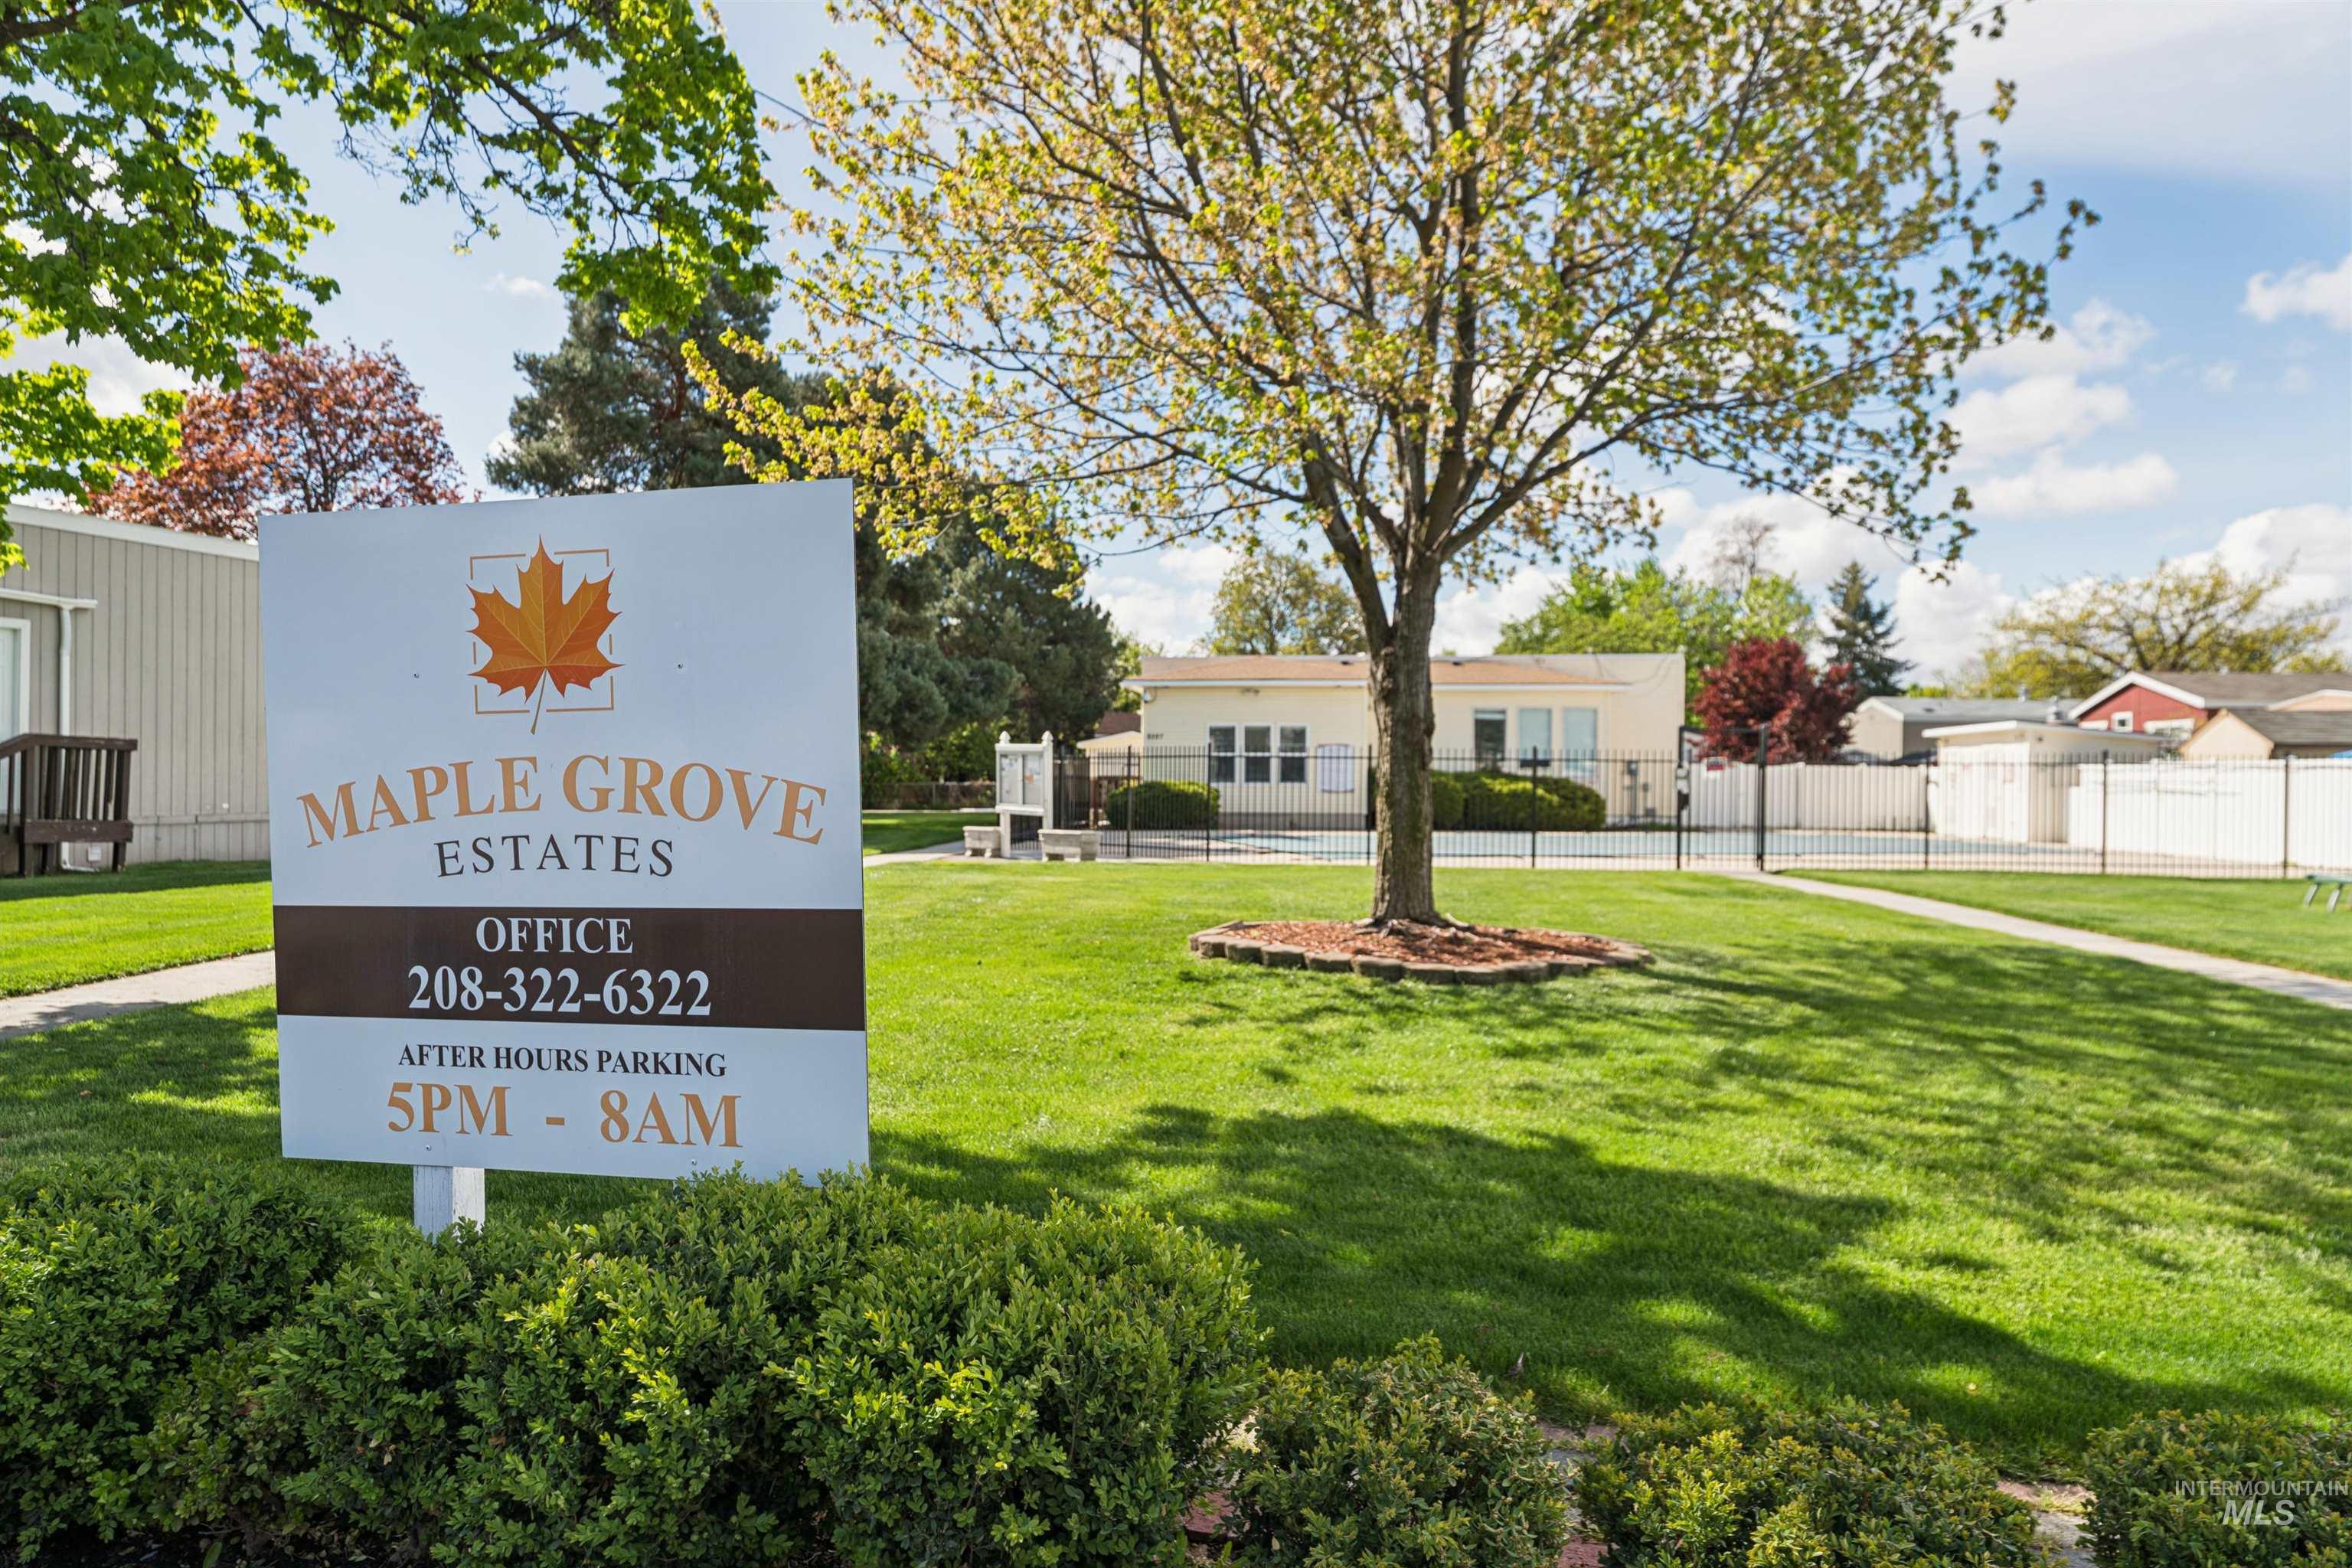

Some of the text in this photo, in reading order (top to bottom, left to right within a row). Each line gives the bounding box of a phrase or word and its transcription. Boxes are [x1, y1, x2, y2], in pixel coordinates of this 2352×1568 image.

[296, 754, 828, 848] MAPLE GROVE
[434, 834, 675, 878] ESTATES
[475, 916, 634, 955] OFFICE
[408, 965, 711, 1017] 208-322-6322
[398, 1044, 727, 1077] AFTER HOURS PARKING
[387, 1082, 743, 1148] 5PM - 8AM
